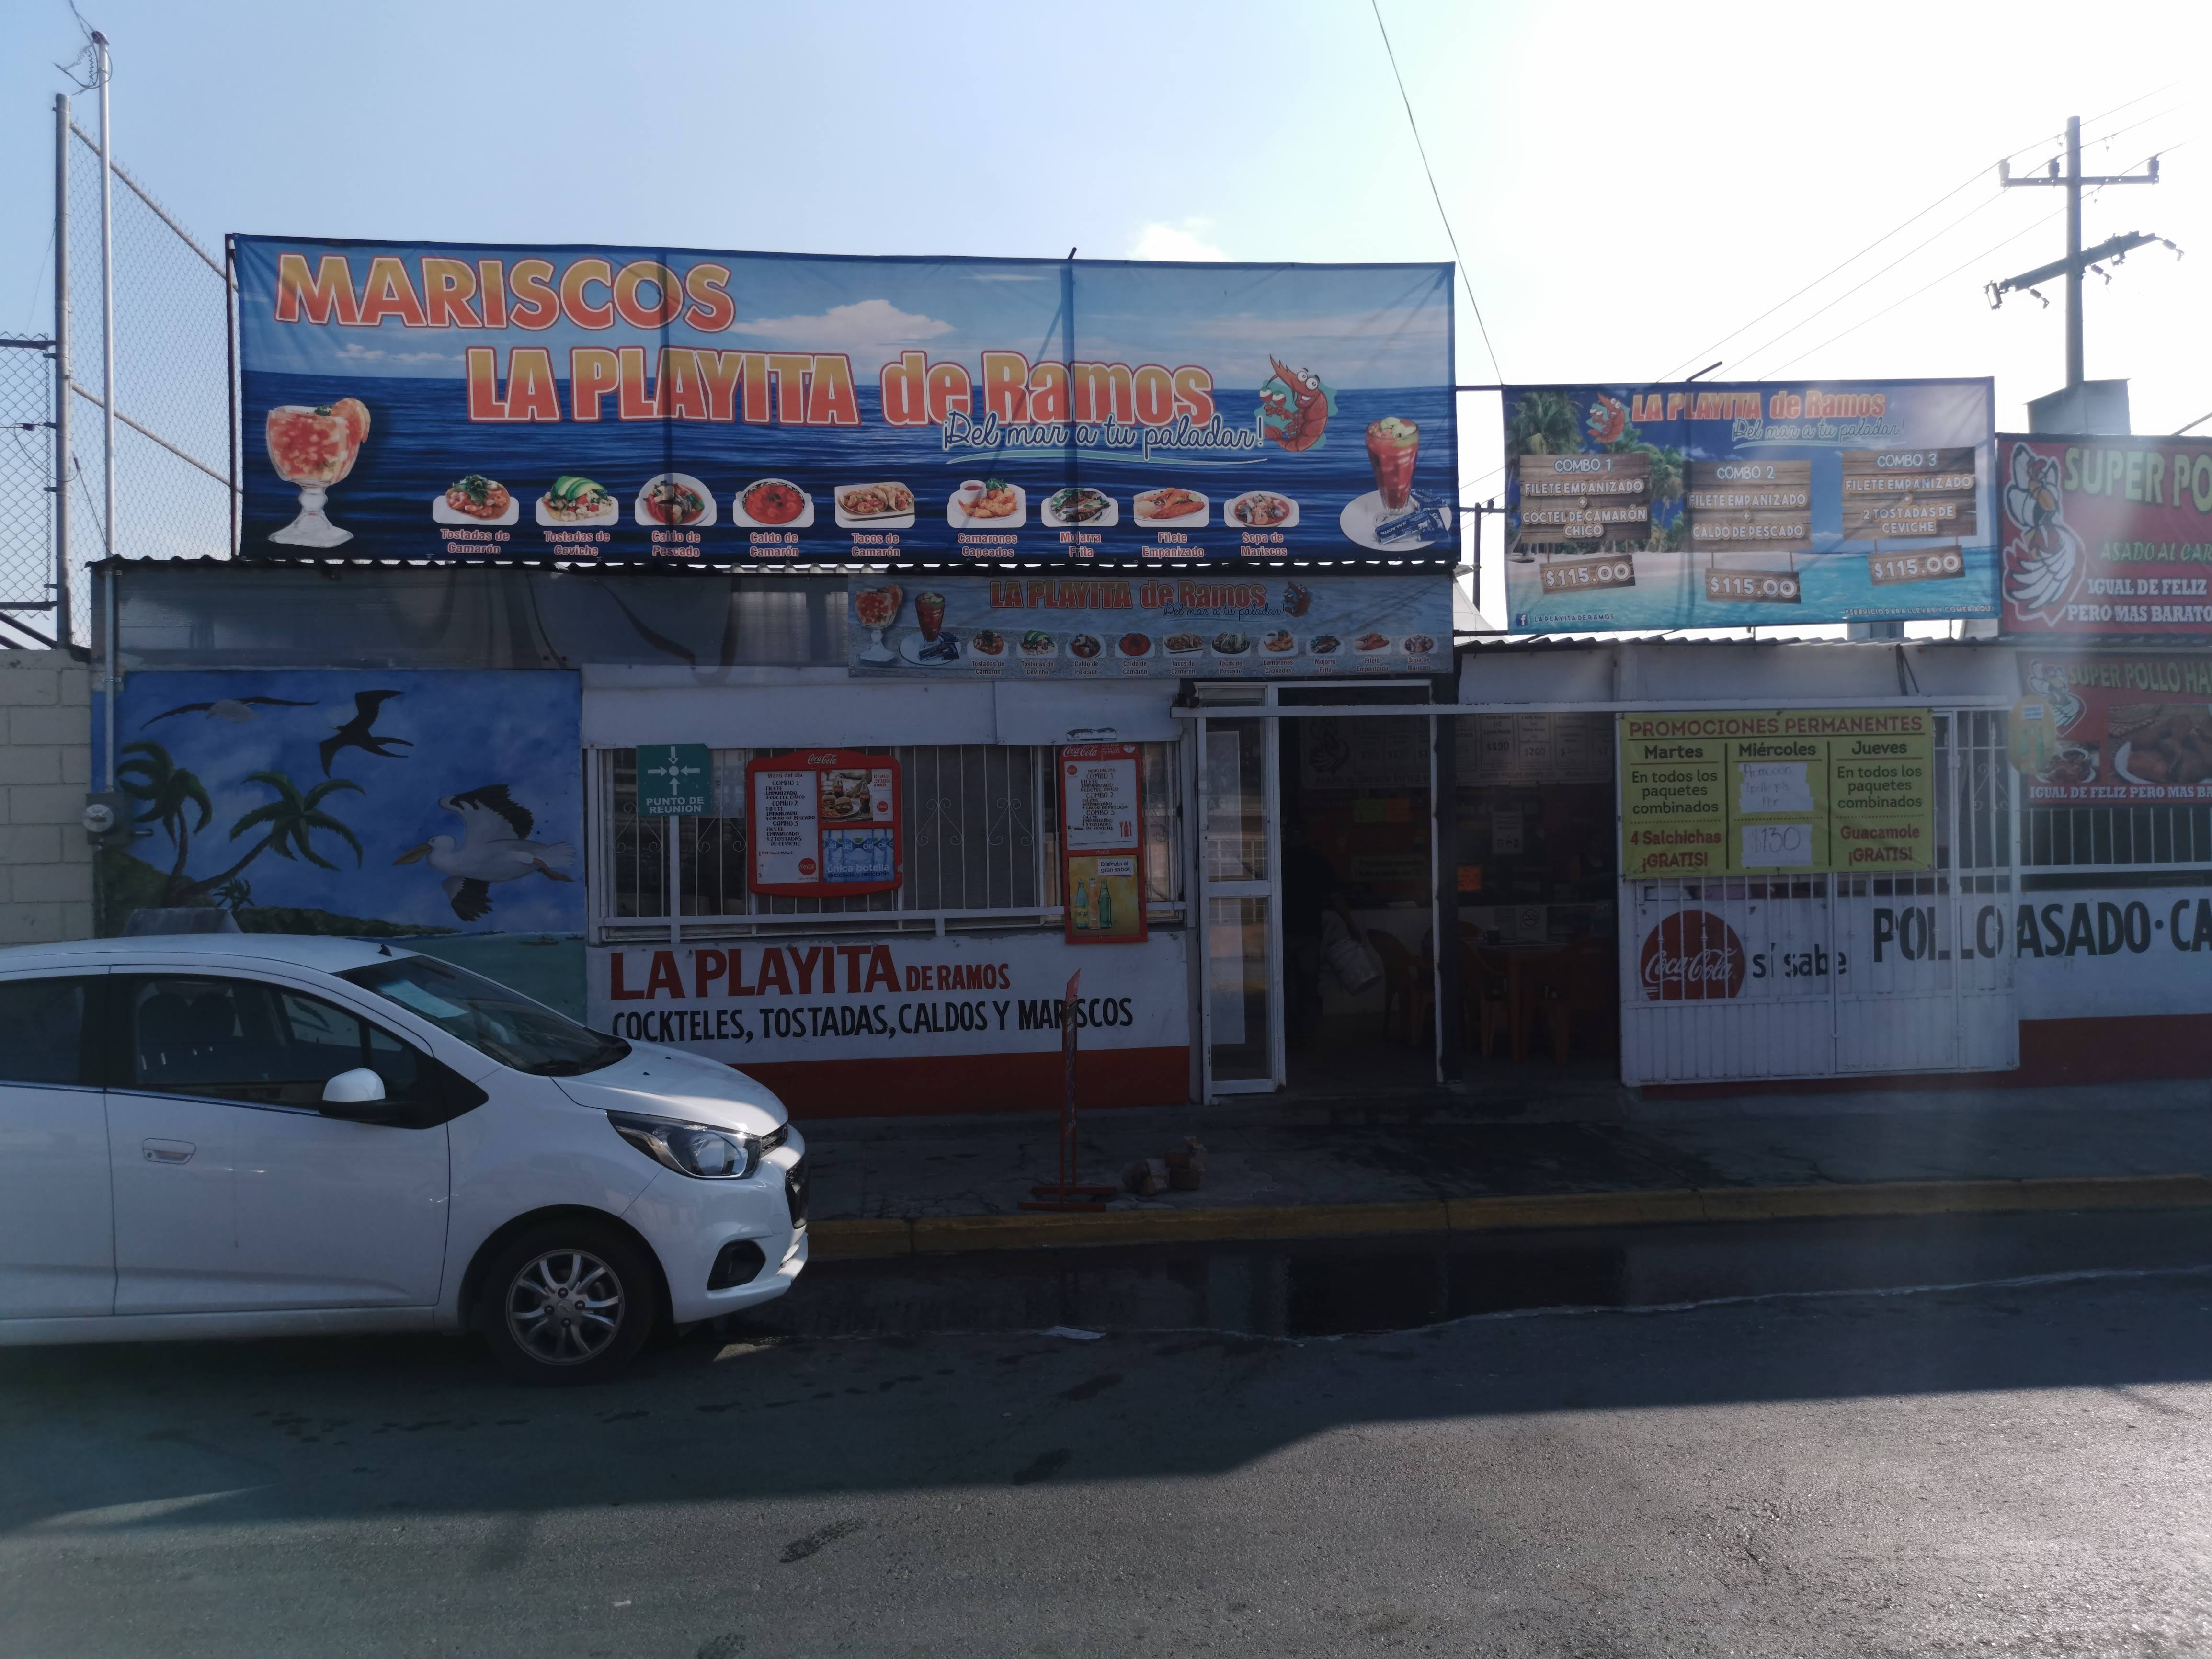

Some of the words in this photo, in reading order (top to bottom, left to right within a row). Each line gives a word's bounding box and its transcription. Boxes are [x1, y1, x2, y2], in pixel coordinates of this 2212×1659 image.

[274, 253, 736, 333] MARISCOS
[466, 346, 562, 422] LA
[570, 345, 862, 427] PLAYITA
[879, 350, 973, 427] de
[981, 350, 1216, 428] Ramos
[1631, 393, 1663, 422] LA
[1667, 391, 1762, 420] PLAYITA
[1769, 390, 1801, 419] de
[1804, 389, 1886, 419] Ramos
[1005, 421, 1070, 447] mar
[1075, 423, 1099, 447] a
[1102, 413, 1136, 446] tu
[1141, 413, 1266, 461] paladar!
[1554, 458, 1601, 472] COMBO
[1605, 458, 1612, 472] 1
[1877, 453, 1923, 467] COMBO
[1928, 453, 1938, 466] 3
[1717, 466, 1761, 479] COMBO
[1766, 466, 1775, 479] 2
[2064, 447, 2166, 504] SUPER
[1524, 482, 1562, 494] FILETE
[1563, 480, 1643, 494] EMPANIZADO
[1845, 479, 1884, 491] FILETE
[1887, 476, 1972, 490] EMPANIZADO
[1689, 494, 1724, 506] FILETE
[1728, 493, 1806, 506] EMPANIZADO
[1522, 510, 1566, 523] CÓCTEL
[1569, 512, 1583, 522] DE
[1585, 505, 1646, 522] CAMARÓN
[1863, 509, 1870, 520] 2
[1873, 507, 1936, 519] TOSTADAS
[1938, 506, 1954, 518] DE
[1564, 525, 1603, 536] CHICO
[1693, 526, 1730, 538] CALDO
[1733, 526, 1745, 537] DE
[1749, 525, 1803, 538] PESCADO
[1881, 521, 1935, 534] CEVICHE
[440, 528, 492, 541] Tostadas
[495, 530, 510, 542] de
[544, 531, 593, 543] Tostadas
[596, 531, 610, 542] de
[651, 530, 684, 543] Caldo
[686, 530, 701, 543] de
[750, 532, 782, 544] Caldo
[784, 532, 798, 544] de
[852, 532, 883, 544] Tacos
[885, 532, 899, 544] de
[958, 532, 1017, 544] Camarones
[1060, 531, 1102, 545] Mojarra
[1157, 532, 1187, 543] Filete
[1242, 532, 1268, 545] Sopa
[1270, 532, 1284, 543] de
[447, 542, 501, 554] Camarón
[554, 545, 599, 557] Ceviche
[652, 545, 700, 557] Pescado
[749, 546, 799, 557] Camarón
[851, 546, 901, 557] Camarón
[962, 546, 1015, 558] Capeados
[1069, 546, 1094, 557] Frita
[1142, 546, 1205, 559] Empanizado
[1241, 546, 1288, 557] Mariscos
[2099, 541, 2155, 561] ASADO
[2157, 542, 2177, 562] AL
[1873, 554, 1960, 579] $115.00
[1545, 563, 1629, 587] $115.00
[1710, 576, 1796, 596] $115.00
[2087, 579, 2134, 595] IGUAL
[2137, 579, 2159, 595] DE
[2161, 578, 2207, 595] FELIZ
[990, 580, 1024, 608] LA
[1026, 580, 1133, 609] PLAYITA
[1140, 579, 1174, 608] de
[1177, 580, 1267, 608] Ramos
[2066, 604, 2111, 621] PERO
[2115, 605, 2148, 622] MAS
[2151, 605, 2212, 622] BARATO
[2068, 664, 2121, 687] SUPER
[2125, 661, 2181, 693] POLLO
[1629, 718, 1779, 737] PROMOCIONES
[1784, 716, 1923, 734] PERMANENTES
[1063, 744, 1099, 757] Coca-Cola
[1644, 744, 1704, 760] Martes
[1738, 740, 1817, 757] Miércoles
[1851, 740, 1908, 755] Jueves
[808, 754, 838, 765] Coca-Cola
[1632, 771, 1648, 784] En
[1651, 770, 1693, 783] todos
[1697, 769, 1718, 782] los
[1836, 766, 1854, 778] En
[1857, 765, 1898, 778] todos
[1902, 764, 1922, 777] los
[1642, 784, 1708, 800] paquetes
[1847, 780, 1912, 795] paquetes
[2029, 786, 2068, 798] IGUAL
[2070, 786, 2087, 798] DE
[2089, 786, 2127, 798] FELIZ
[2130, 786, 2165, 798] PERO
[2167, 786, 2194, 798] MAS
[646, 797, 685, 806] PUNTO
[1632, 802, 1719, 815] combinados
[1837, 796, 1923, 808] combinados
[649, 805, 702, 814] REUNION
[1630, 831, 1639, 845] 4
[1642, 829, 1722, 845] Salchichas
[1840, 824, 1920, 840] Guacamole
[1642, 852, 1709, 873] ¡GRATIS!
[1848, 847, 1913, 866] ¡GRATIS!
[827, 864, 853, 872] única
[856, 864, 889, 872] botella
[2016, 900, 2151, 958] ASADO
[1644, 948, 1737, 984] Coca-Cola
[1784, 943, 1847, 978] sabe
[611, 951, 686, 1000] LA
[695, 944, 901, 998] PLAYITA
[906, 965, 934, 992] DE
[936, 963, 1011, 991] RAMOS
[613, 1009, 754, 1044] COCKTELES,
[759, 1004, 896, 1039] TOSTADAS,
[898, 1001, 989, 1034] CALDOS
[992, 1000, 1010, 1030] Y
[1017, 997, 1134, 1030] MARSCOS
